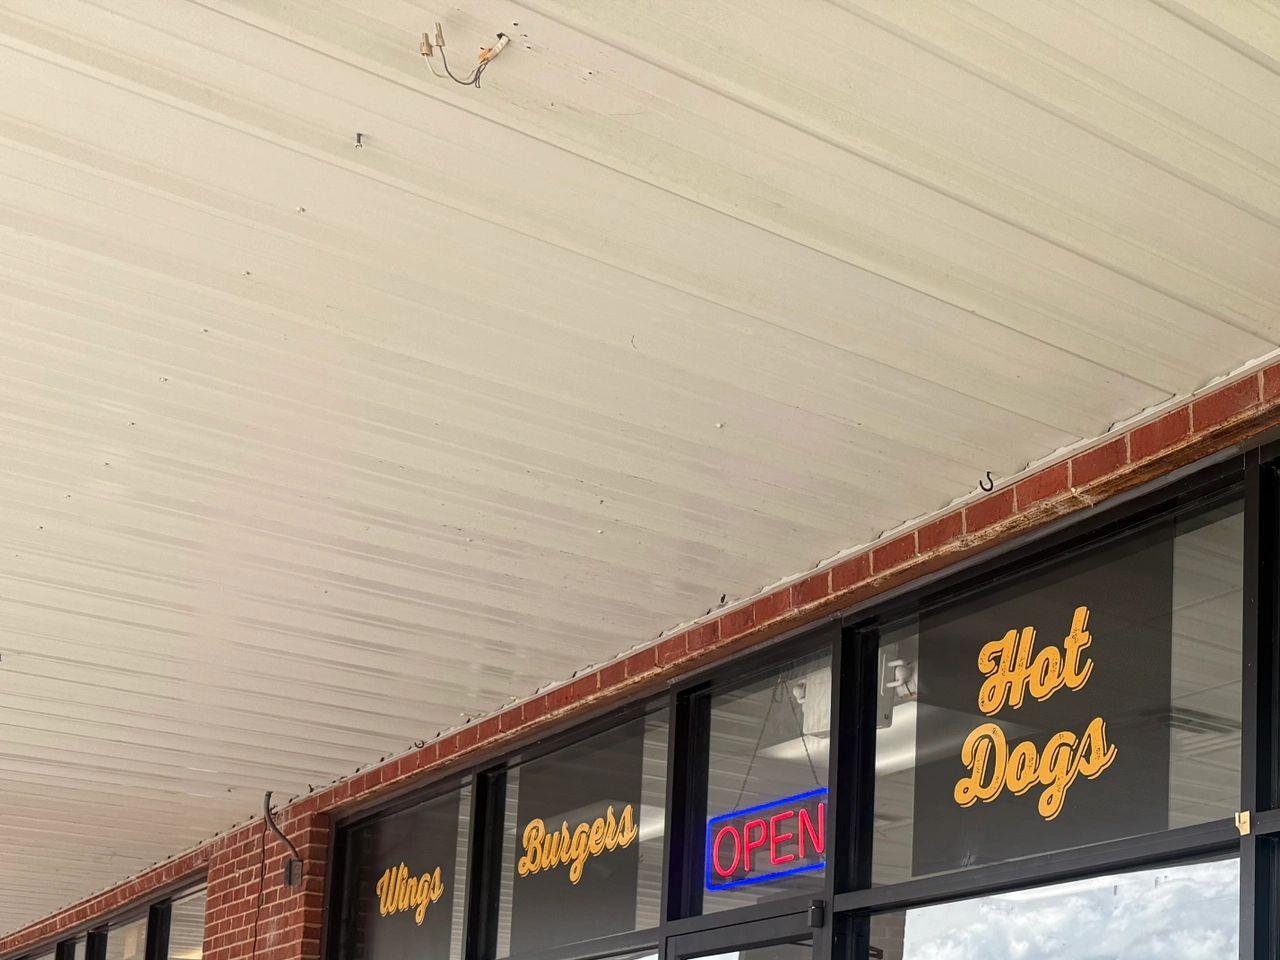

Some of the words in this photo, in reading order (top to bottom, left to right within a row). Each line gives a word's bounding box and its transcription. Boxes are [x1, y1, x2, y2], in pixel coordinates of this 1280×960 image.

[977, 606, 1093, 716] Hot
[954, 717, 1117, 820] Dogs
[518, 804, 638, 884] Burgers
[713, 803, 825, 878] OPEN
[376, 865, 443, 926] Wings
